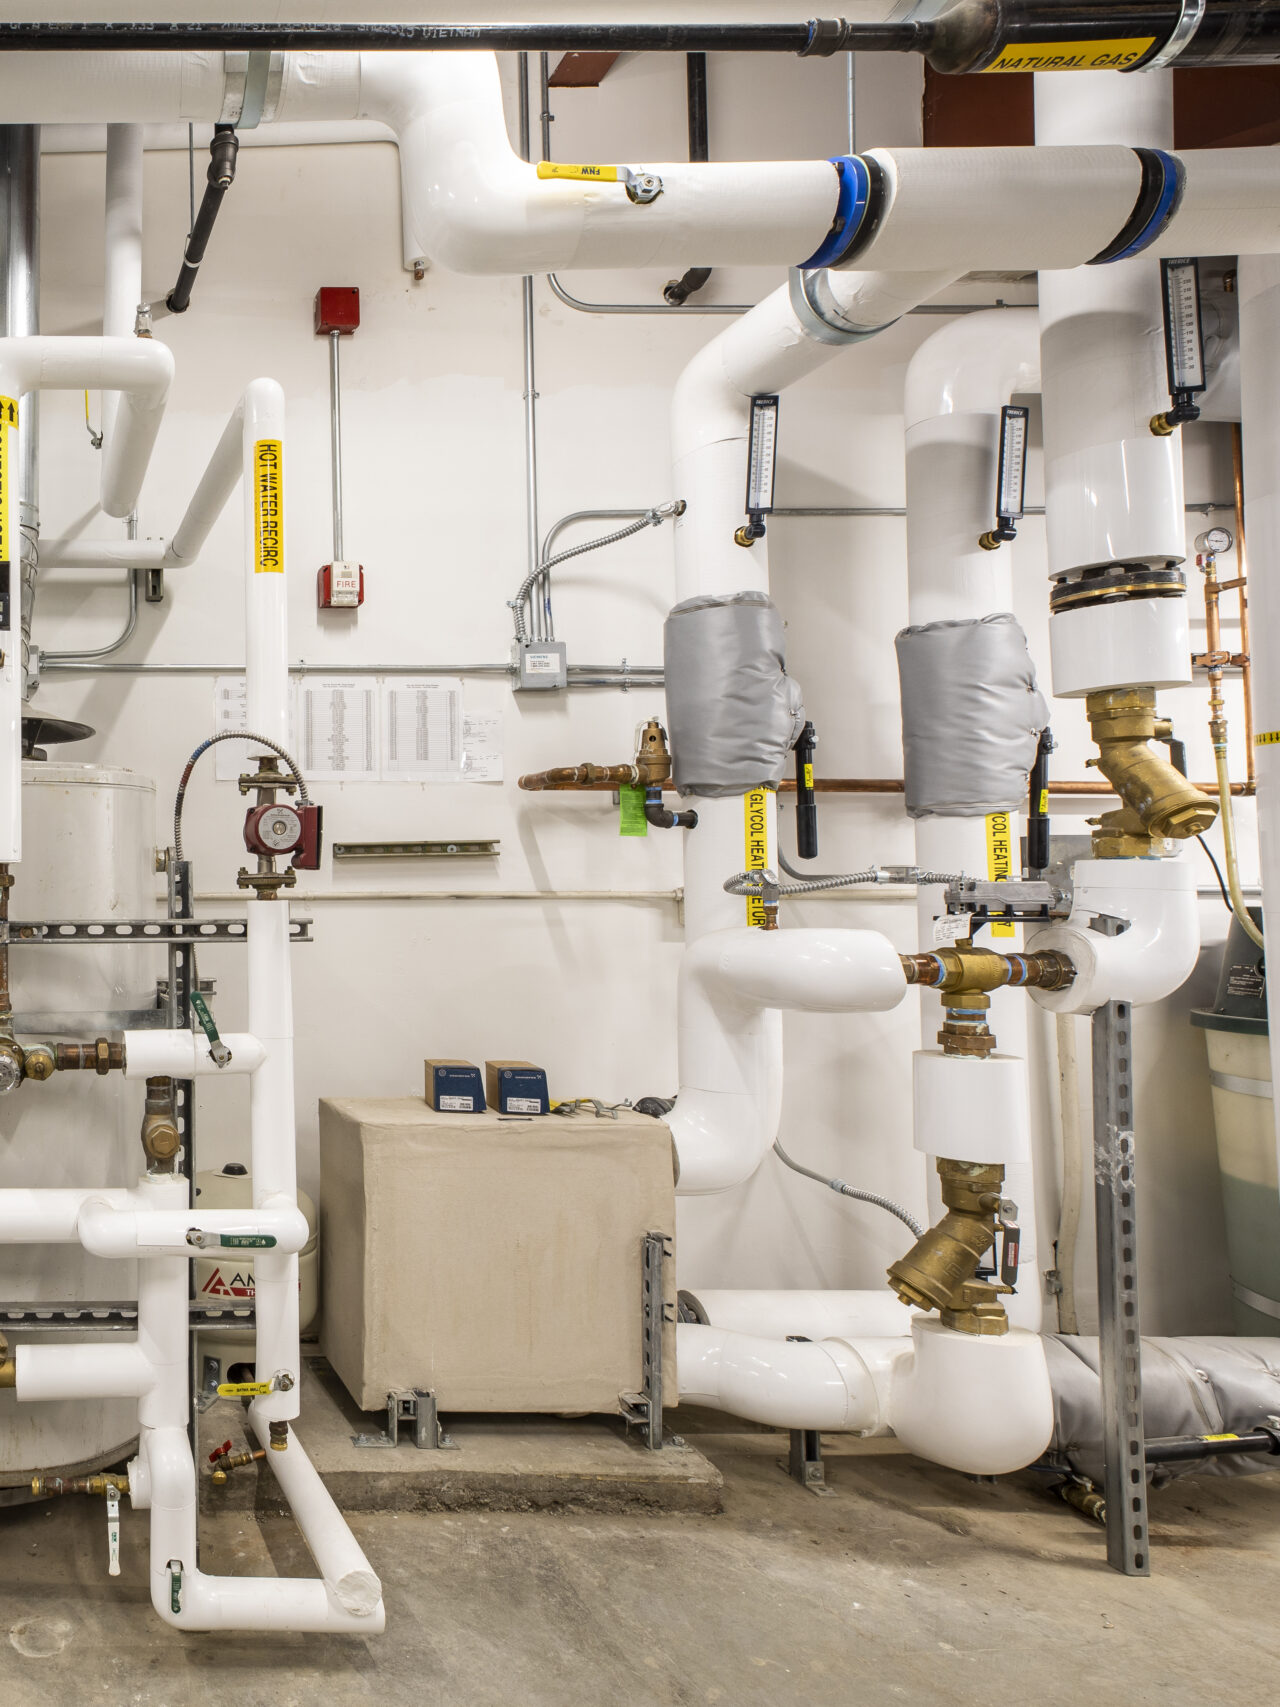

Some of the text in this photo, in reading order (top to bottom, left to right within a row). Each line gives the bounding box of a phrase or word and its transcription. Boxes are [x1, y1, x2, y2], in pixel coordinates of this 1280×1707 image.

[991, 51, 1139, 70] NATURAL GAS
[258, 444, 279, 567] HOT WATER RECIRC
[336, 580, 356, 588] FIRE
[749, 793, 764, 837] GLYCOL
